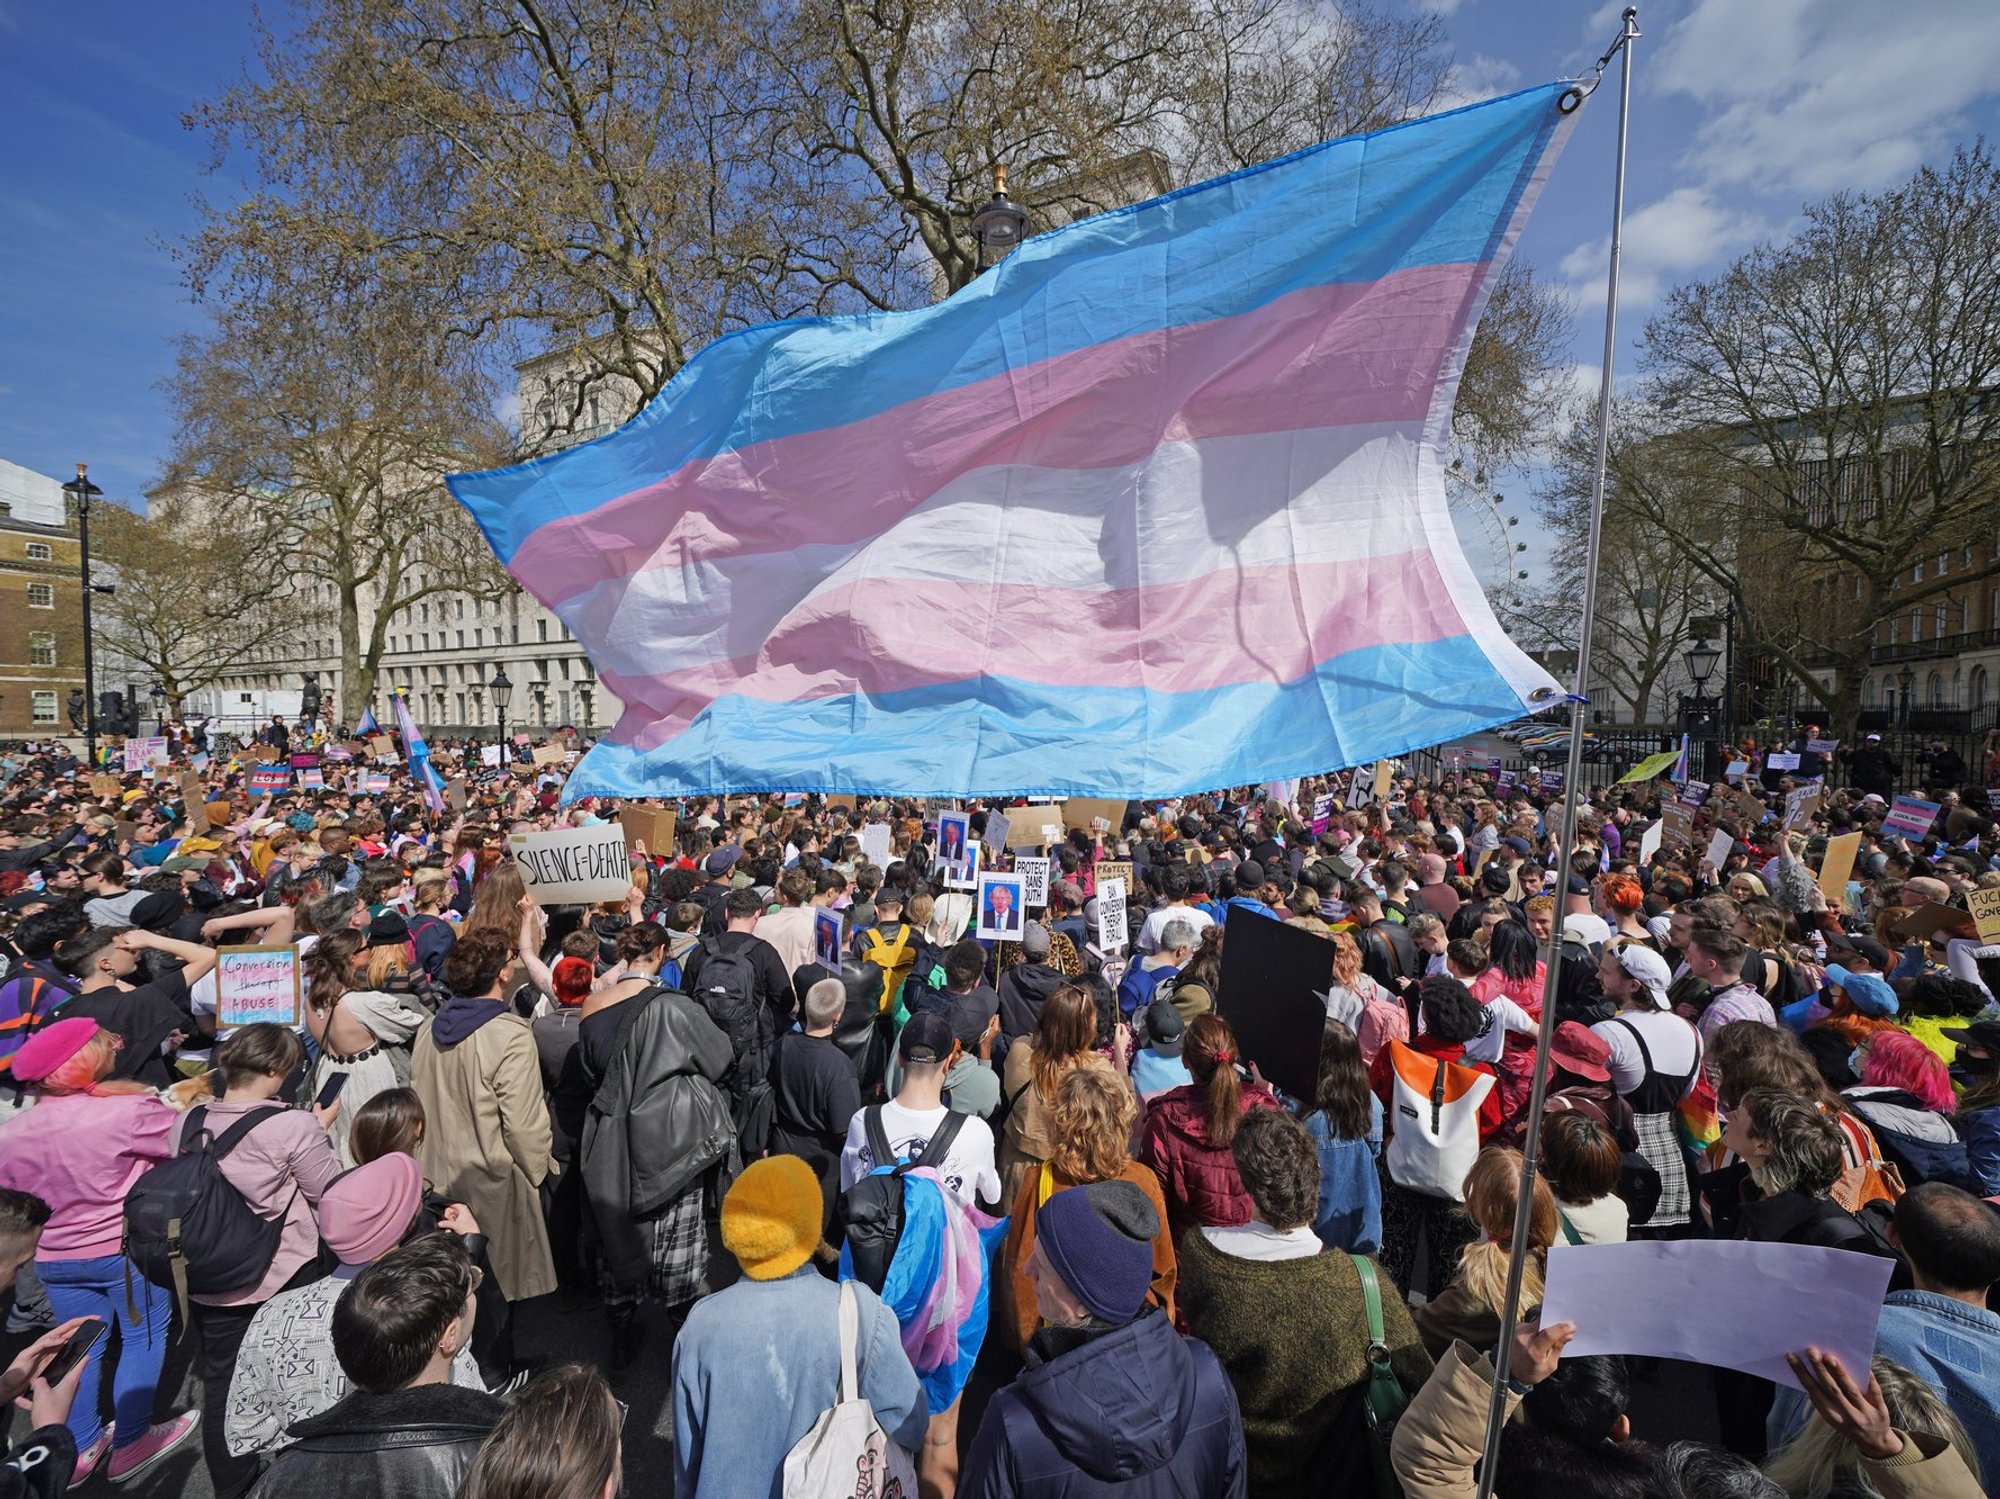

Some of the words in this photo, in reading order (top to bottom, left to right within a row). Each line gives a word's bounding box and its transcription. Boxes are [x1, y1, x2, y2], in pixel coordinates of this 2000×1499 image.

[517, 840, 629, 885] SILENCE=DEATH
[1016, 861, 1048, 875] PROTECT
[1096, 864, 1132, 875] PROTECT
[1025, 875, 1043, 889] RANS
[225, 956, 291, 974] Conversion
[232, 997, 276, 1009] ABUSE
